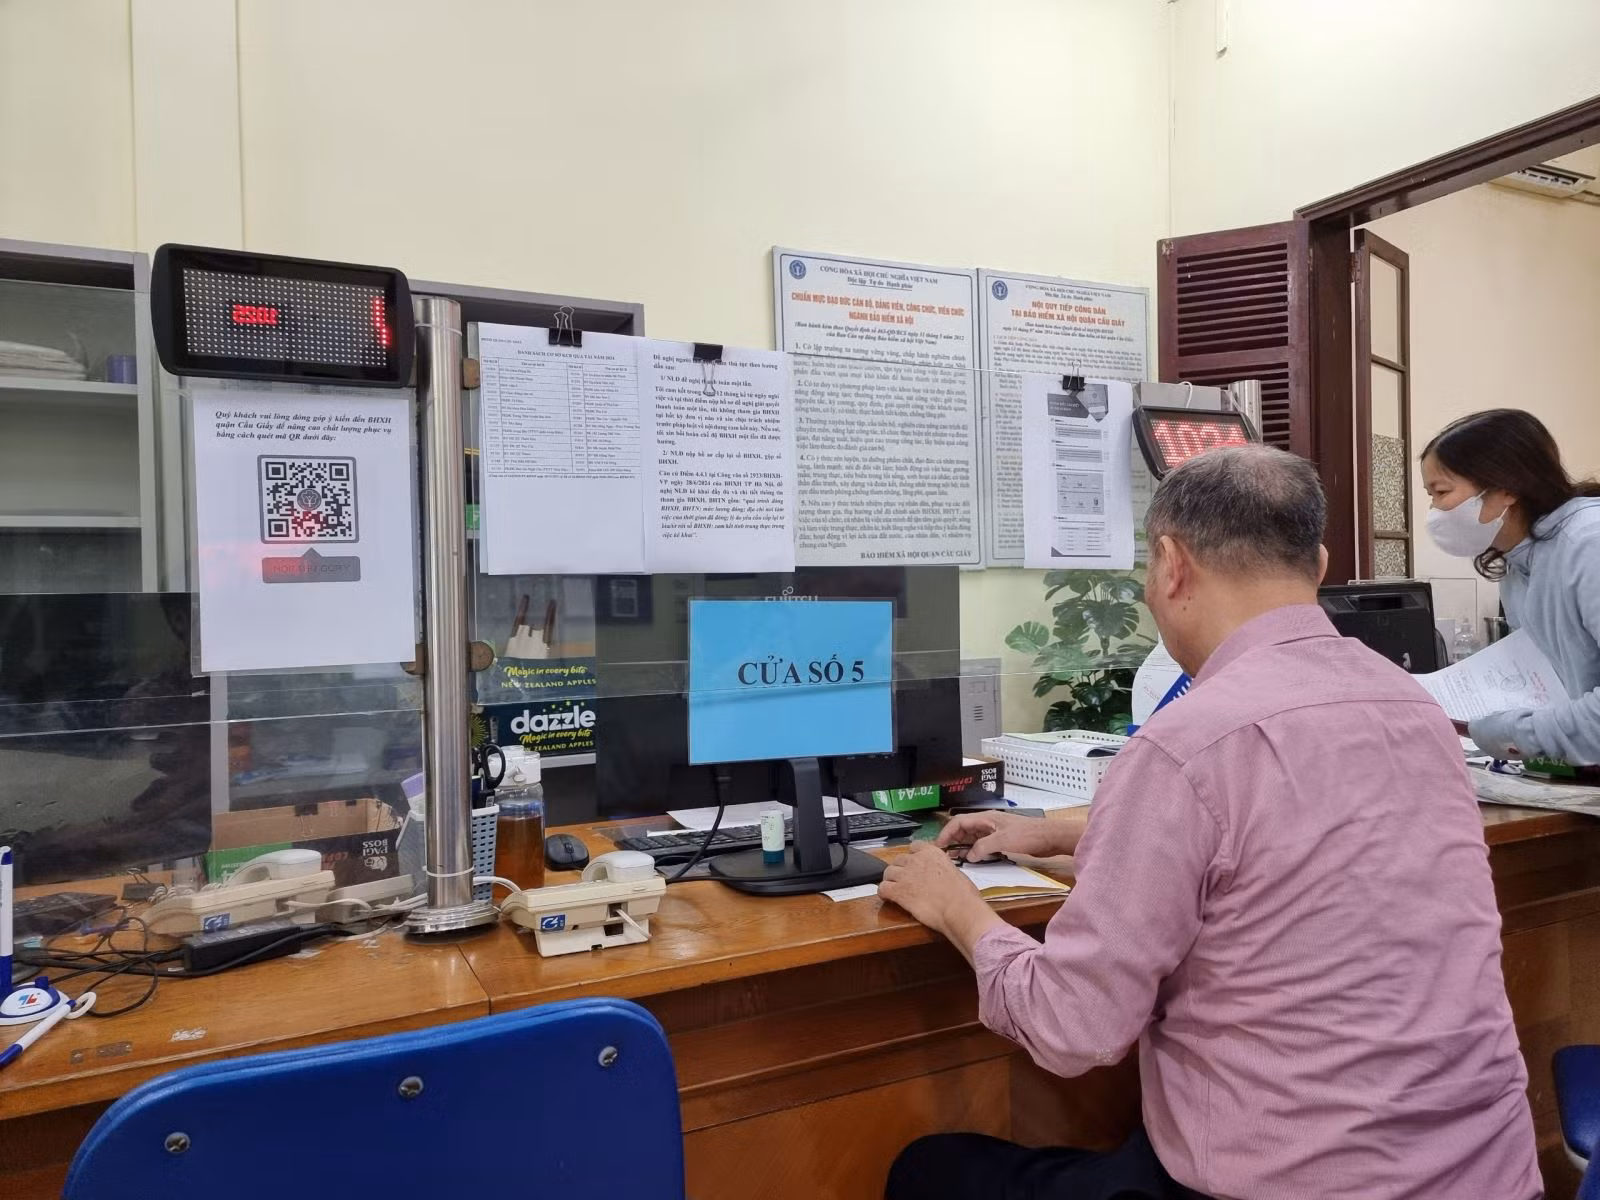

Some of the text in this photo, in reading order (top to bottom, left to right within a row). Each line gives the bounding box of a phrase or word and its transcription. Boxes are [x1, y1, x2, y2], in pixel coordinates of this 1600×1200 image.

[1045, 303, 1057, 311] QUY
[288, 432, 300, 440] QR
[504, 666, 534, 678] Magic
[545, 667, 569, 676] every
[570, 666, 588, 674] bite
[738, 654, 864, 684] CỬA SỐ 5
[501, 680, 521, 688] NEW
[525, 680, 564, 688] ZEALAND
[510, 705, 596, 734] dazzle
[520, 733, 546, 744] Magic
[556, 730, 577, 740] every
[578, 730, 592, 738] bite
[533, 743, 566, 752] ZEALAND
[568, 740, 594, 748] APPLES
